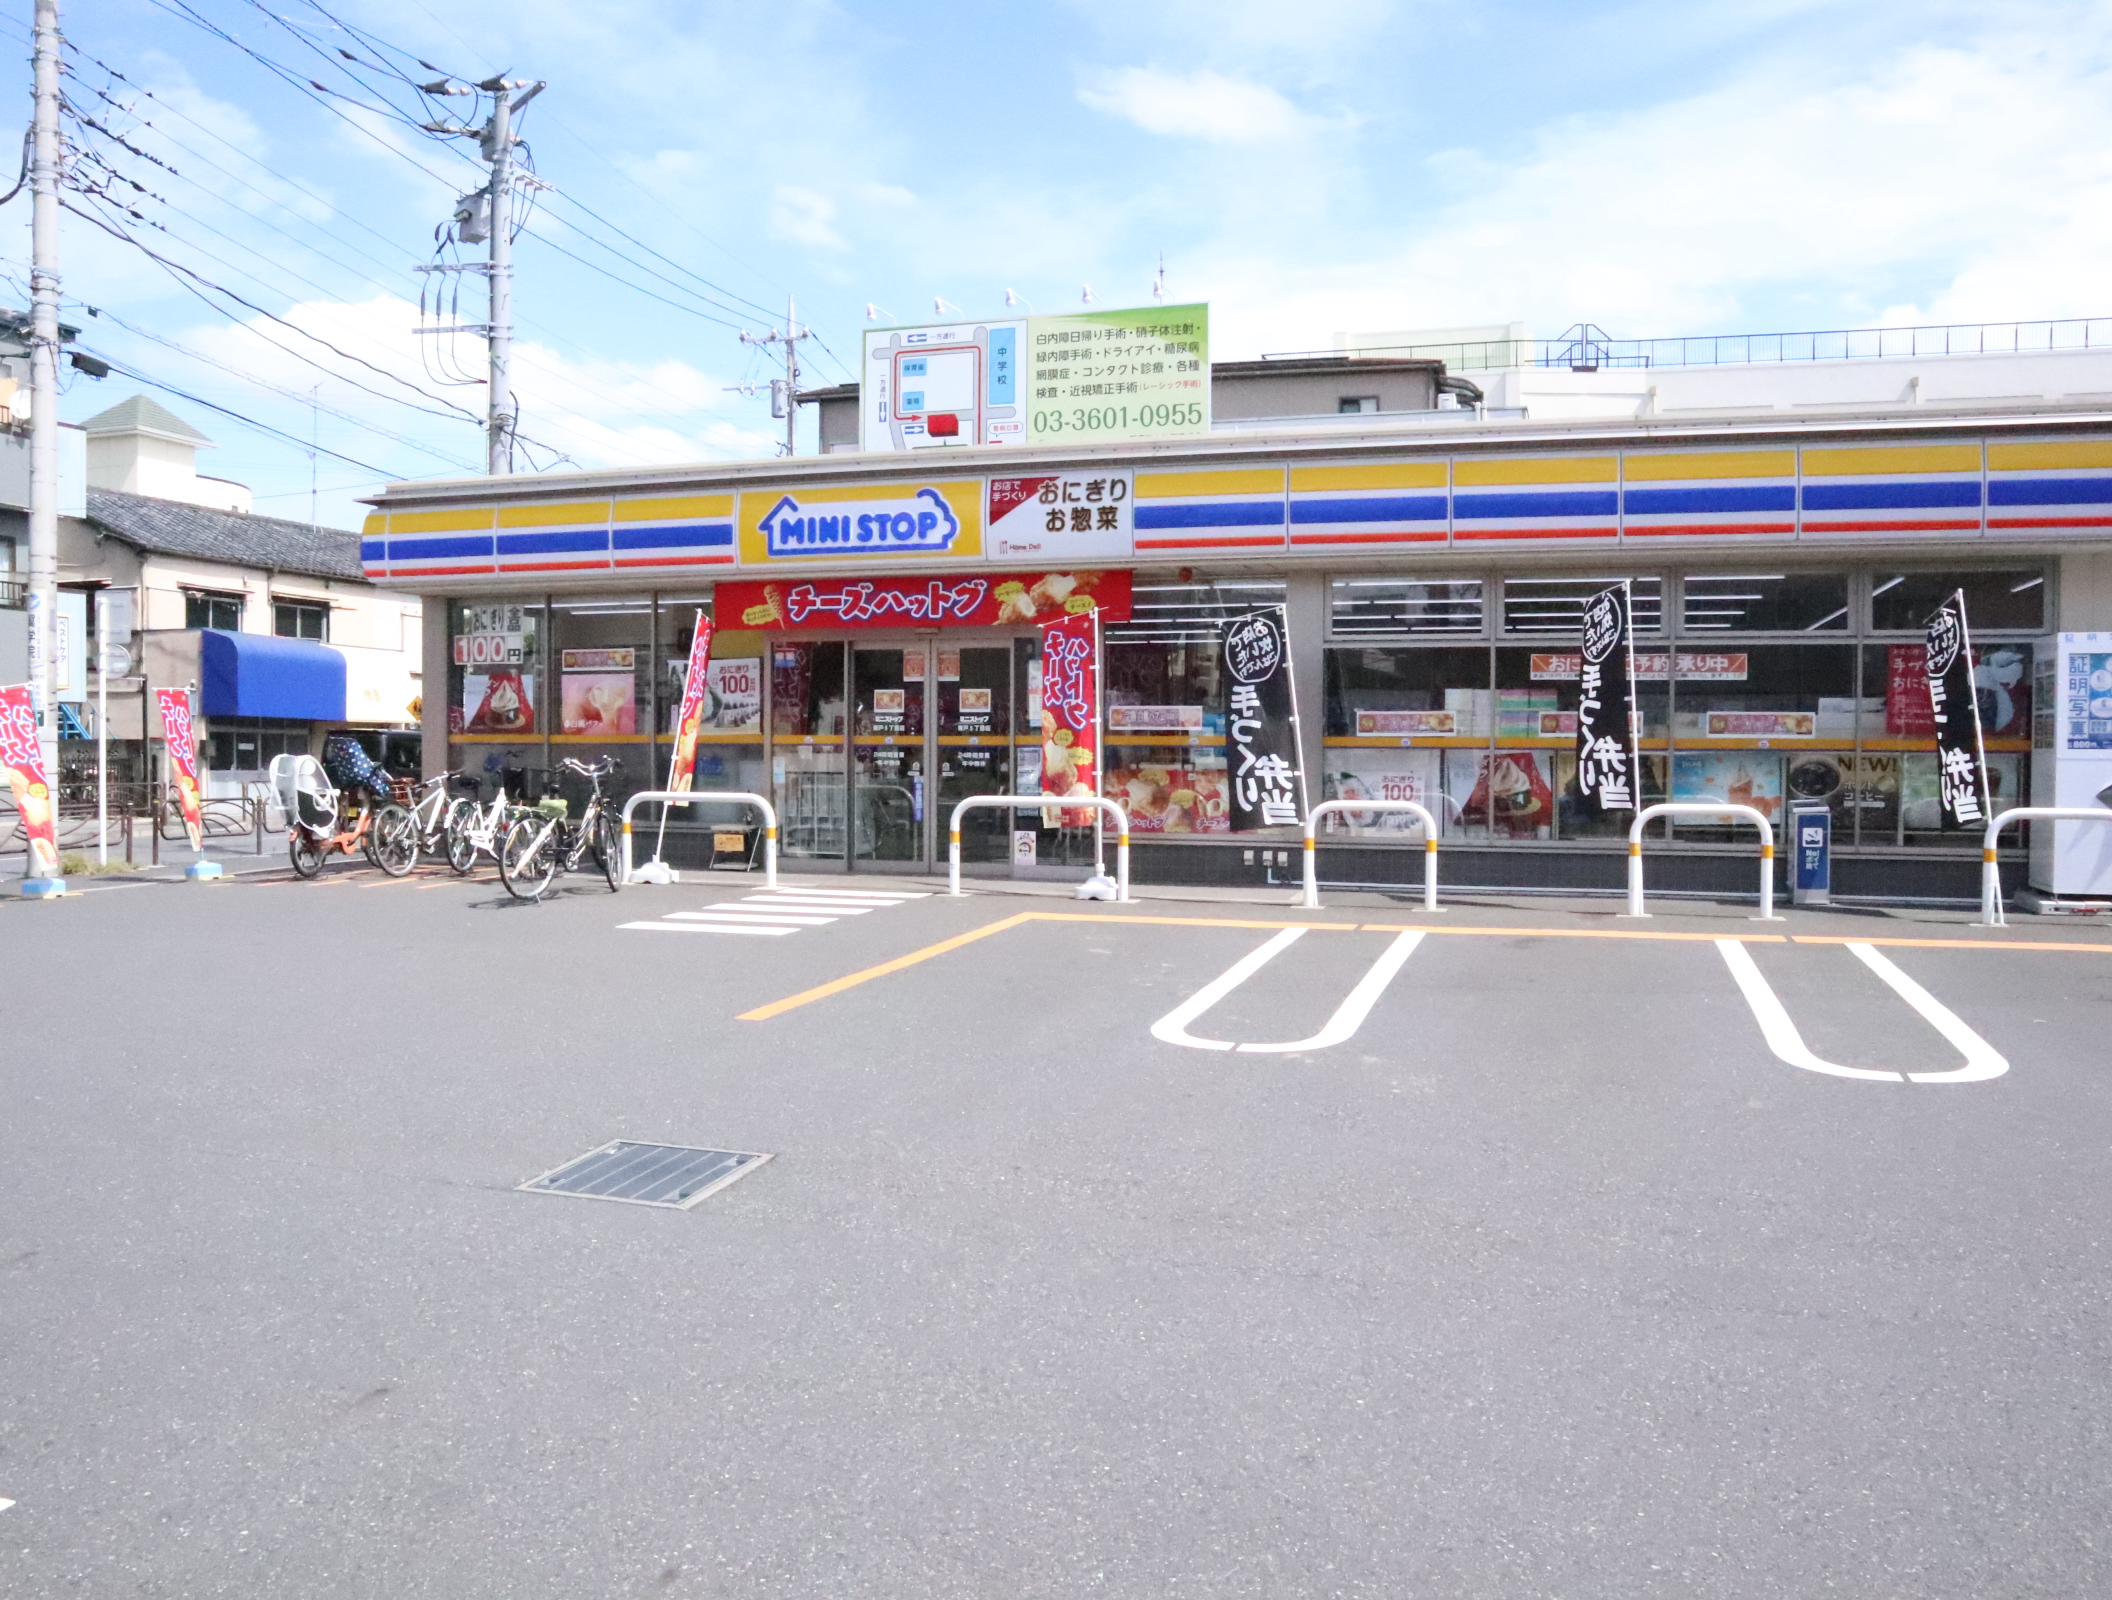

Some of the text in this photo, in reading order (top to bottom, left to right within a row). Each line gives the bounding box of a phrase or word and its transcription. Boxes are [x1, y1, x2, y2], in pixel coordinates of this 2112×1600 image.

[997, 348, 1007, 385] 中学校
[1034, 403, 1202, 433] 03-3601-0955
[992, 491, 1027, 501] 手づくり
[993, 481, 1021, 491] お店で
[1038, 479, 1127, 504] おにぎり
[779, 511, 938, 545] MINI STOP
[1046, 506, 1118, 532] お惣菜
[787, 579, 987, 622] チーズハットグ
[719, 664, 749, 674] おにぎり
[719, 674, 749, 694] 100
[2069, 656, 2087, 737] 証明写真
[1382, 784, 1414, 801] 100
